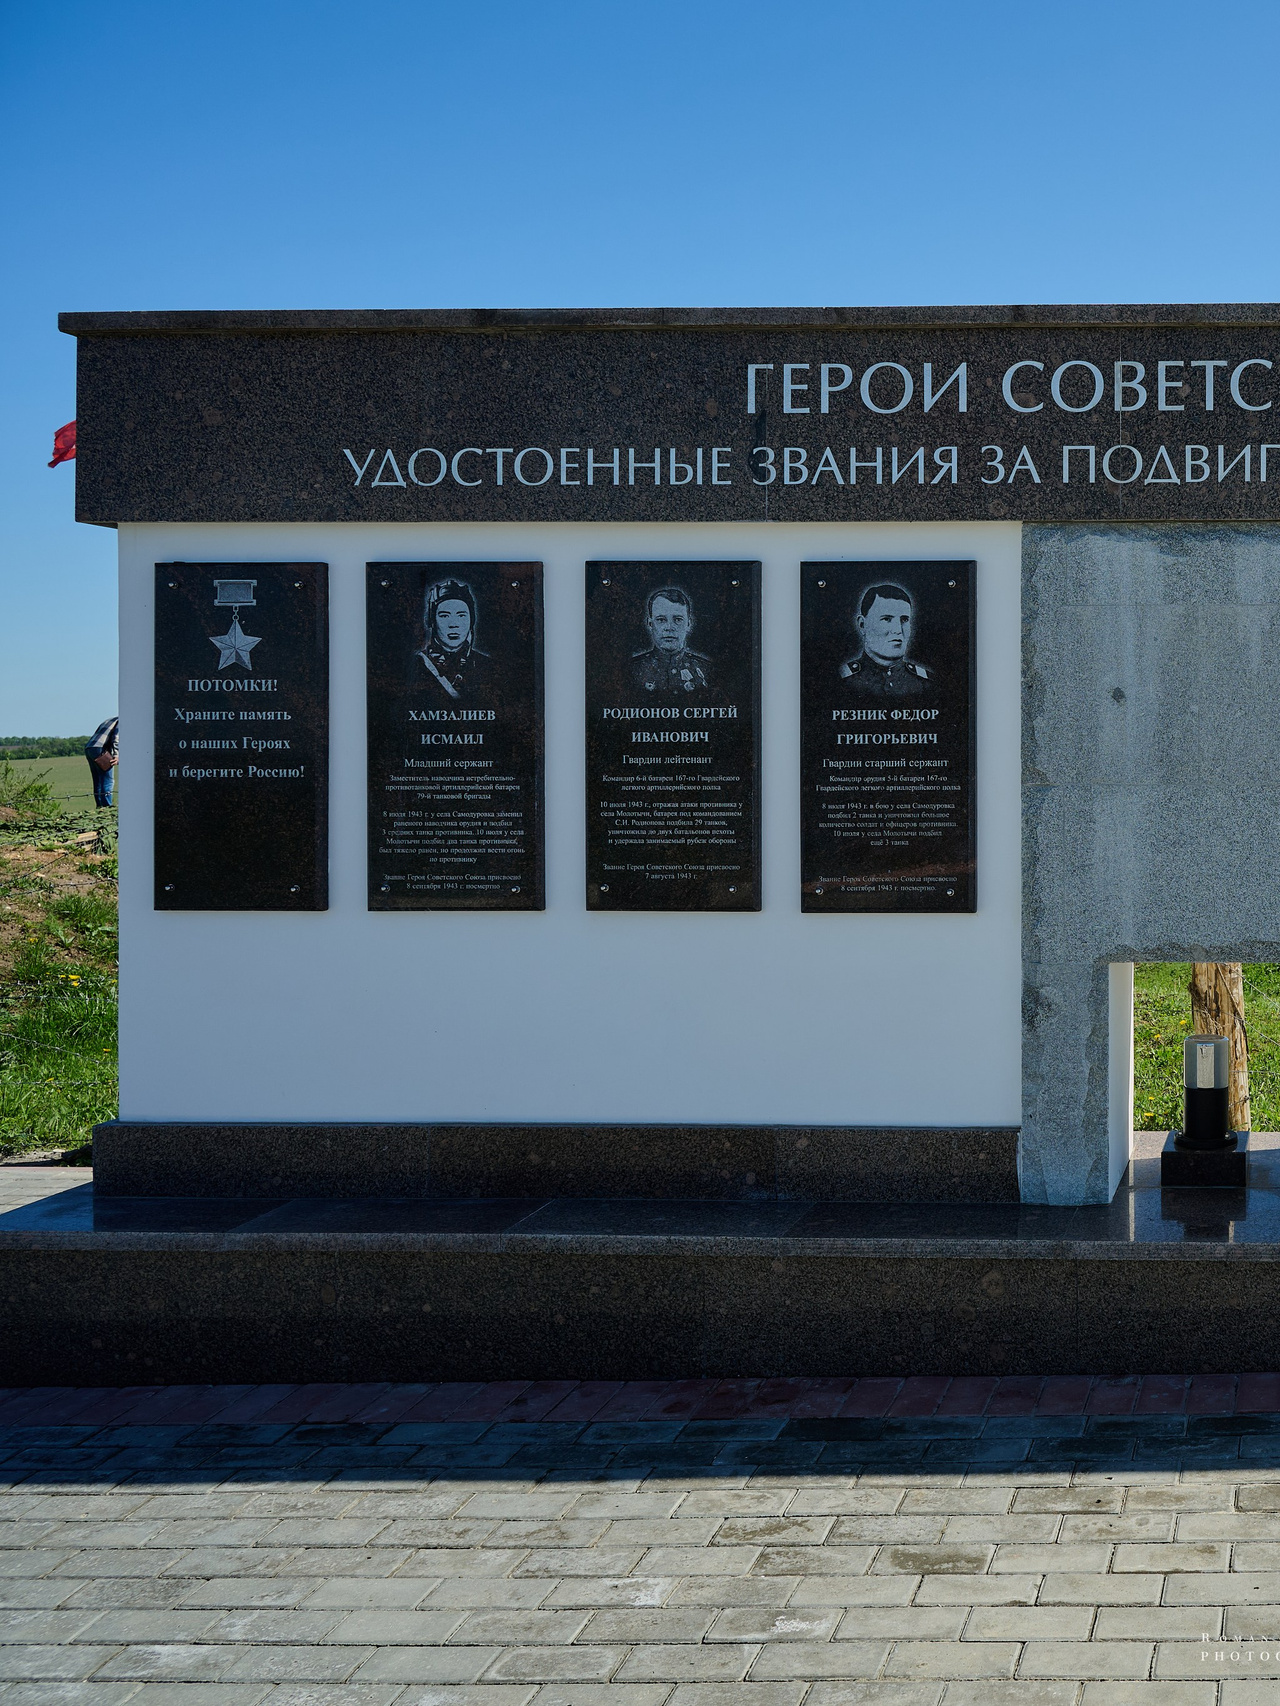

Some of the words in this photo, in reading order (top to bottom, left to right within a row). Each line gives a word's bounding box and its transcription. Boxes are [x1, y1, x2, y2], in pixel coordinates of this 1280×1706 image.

[746, 361, 968, 414] ГЕРОИ
[342, 446, 732, 489] УДОСТОЕННЫЕ
[752, 446, 958, 485] ЗВАНИЯ
[980, 445, 1042, 484] ЗА
[1062, 444, 1280, 485] ПОДВИГ
[188, 679, 278, 692] ПОТОМКИ!
[174, 708, 235, 723] Храните
[239, 711, 292, 720] память
[408, 710, 496, 721] ХАМЗАЛИЕВ
[603, 708, 680, 720] РОДИОНОВ
[683, 706, 738, 718] СЕРГЕЙ
[832, 709, 887, 720] РЕЗНИК
[890, 709, 939, 722] ФЕДОР
[421, 734, 484, 744] ИСМАИЛ
[631, 732, 709, 742] ИВАНОВИЧ
[836, 734, 938, 745] ГРИГОРЬЕВИЧ
[179, 740, 187, 749] о
[191, 740, 238, 749] наших
[242, 736, 291, 752] Героях
[404, 759, 451, 768] Младший
[454, 761, 494, 769] сержант
[623, 755, 661, 766] Гвардии
[664, 755, 713, 764] лейтенант
[823, 759, 862, 769] Гвардии
[865, 759, 906, 769] старший
[909, 761, 949, 769] сержант
[169, 769, 178, 778] и
[182, 766, 244, 780] берегите
[248, 766, 304, 778] Россию!
